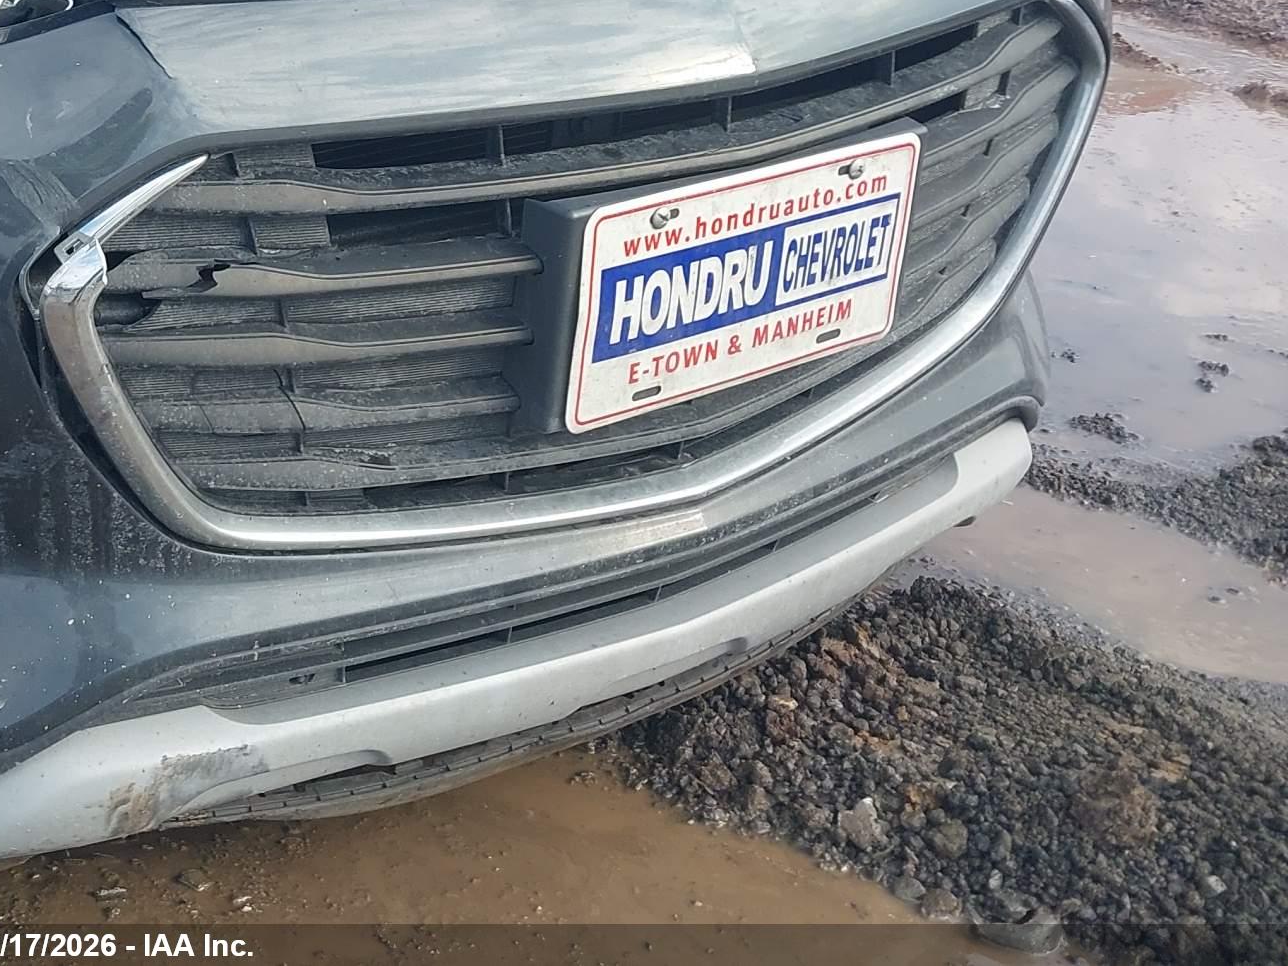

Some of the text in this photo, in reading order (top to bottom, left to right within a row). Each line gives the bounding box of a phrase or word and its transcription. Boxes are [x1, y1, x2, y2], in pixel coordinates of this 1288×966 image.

[623, 174, 888, 257] www.hondruauto.com
[609, 213, 892, 345] HONDRU CHEVROLET
[628, 298, 852, 384] E-TOWN & MANHEIM
